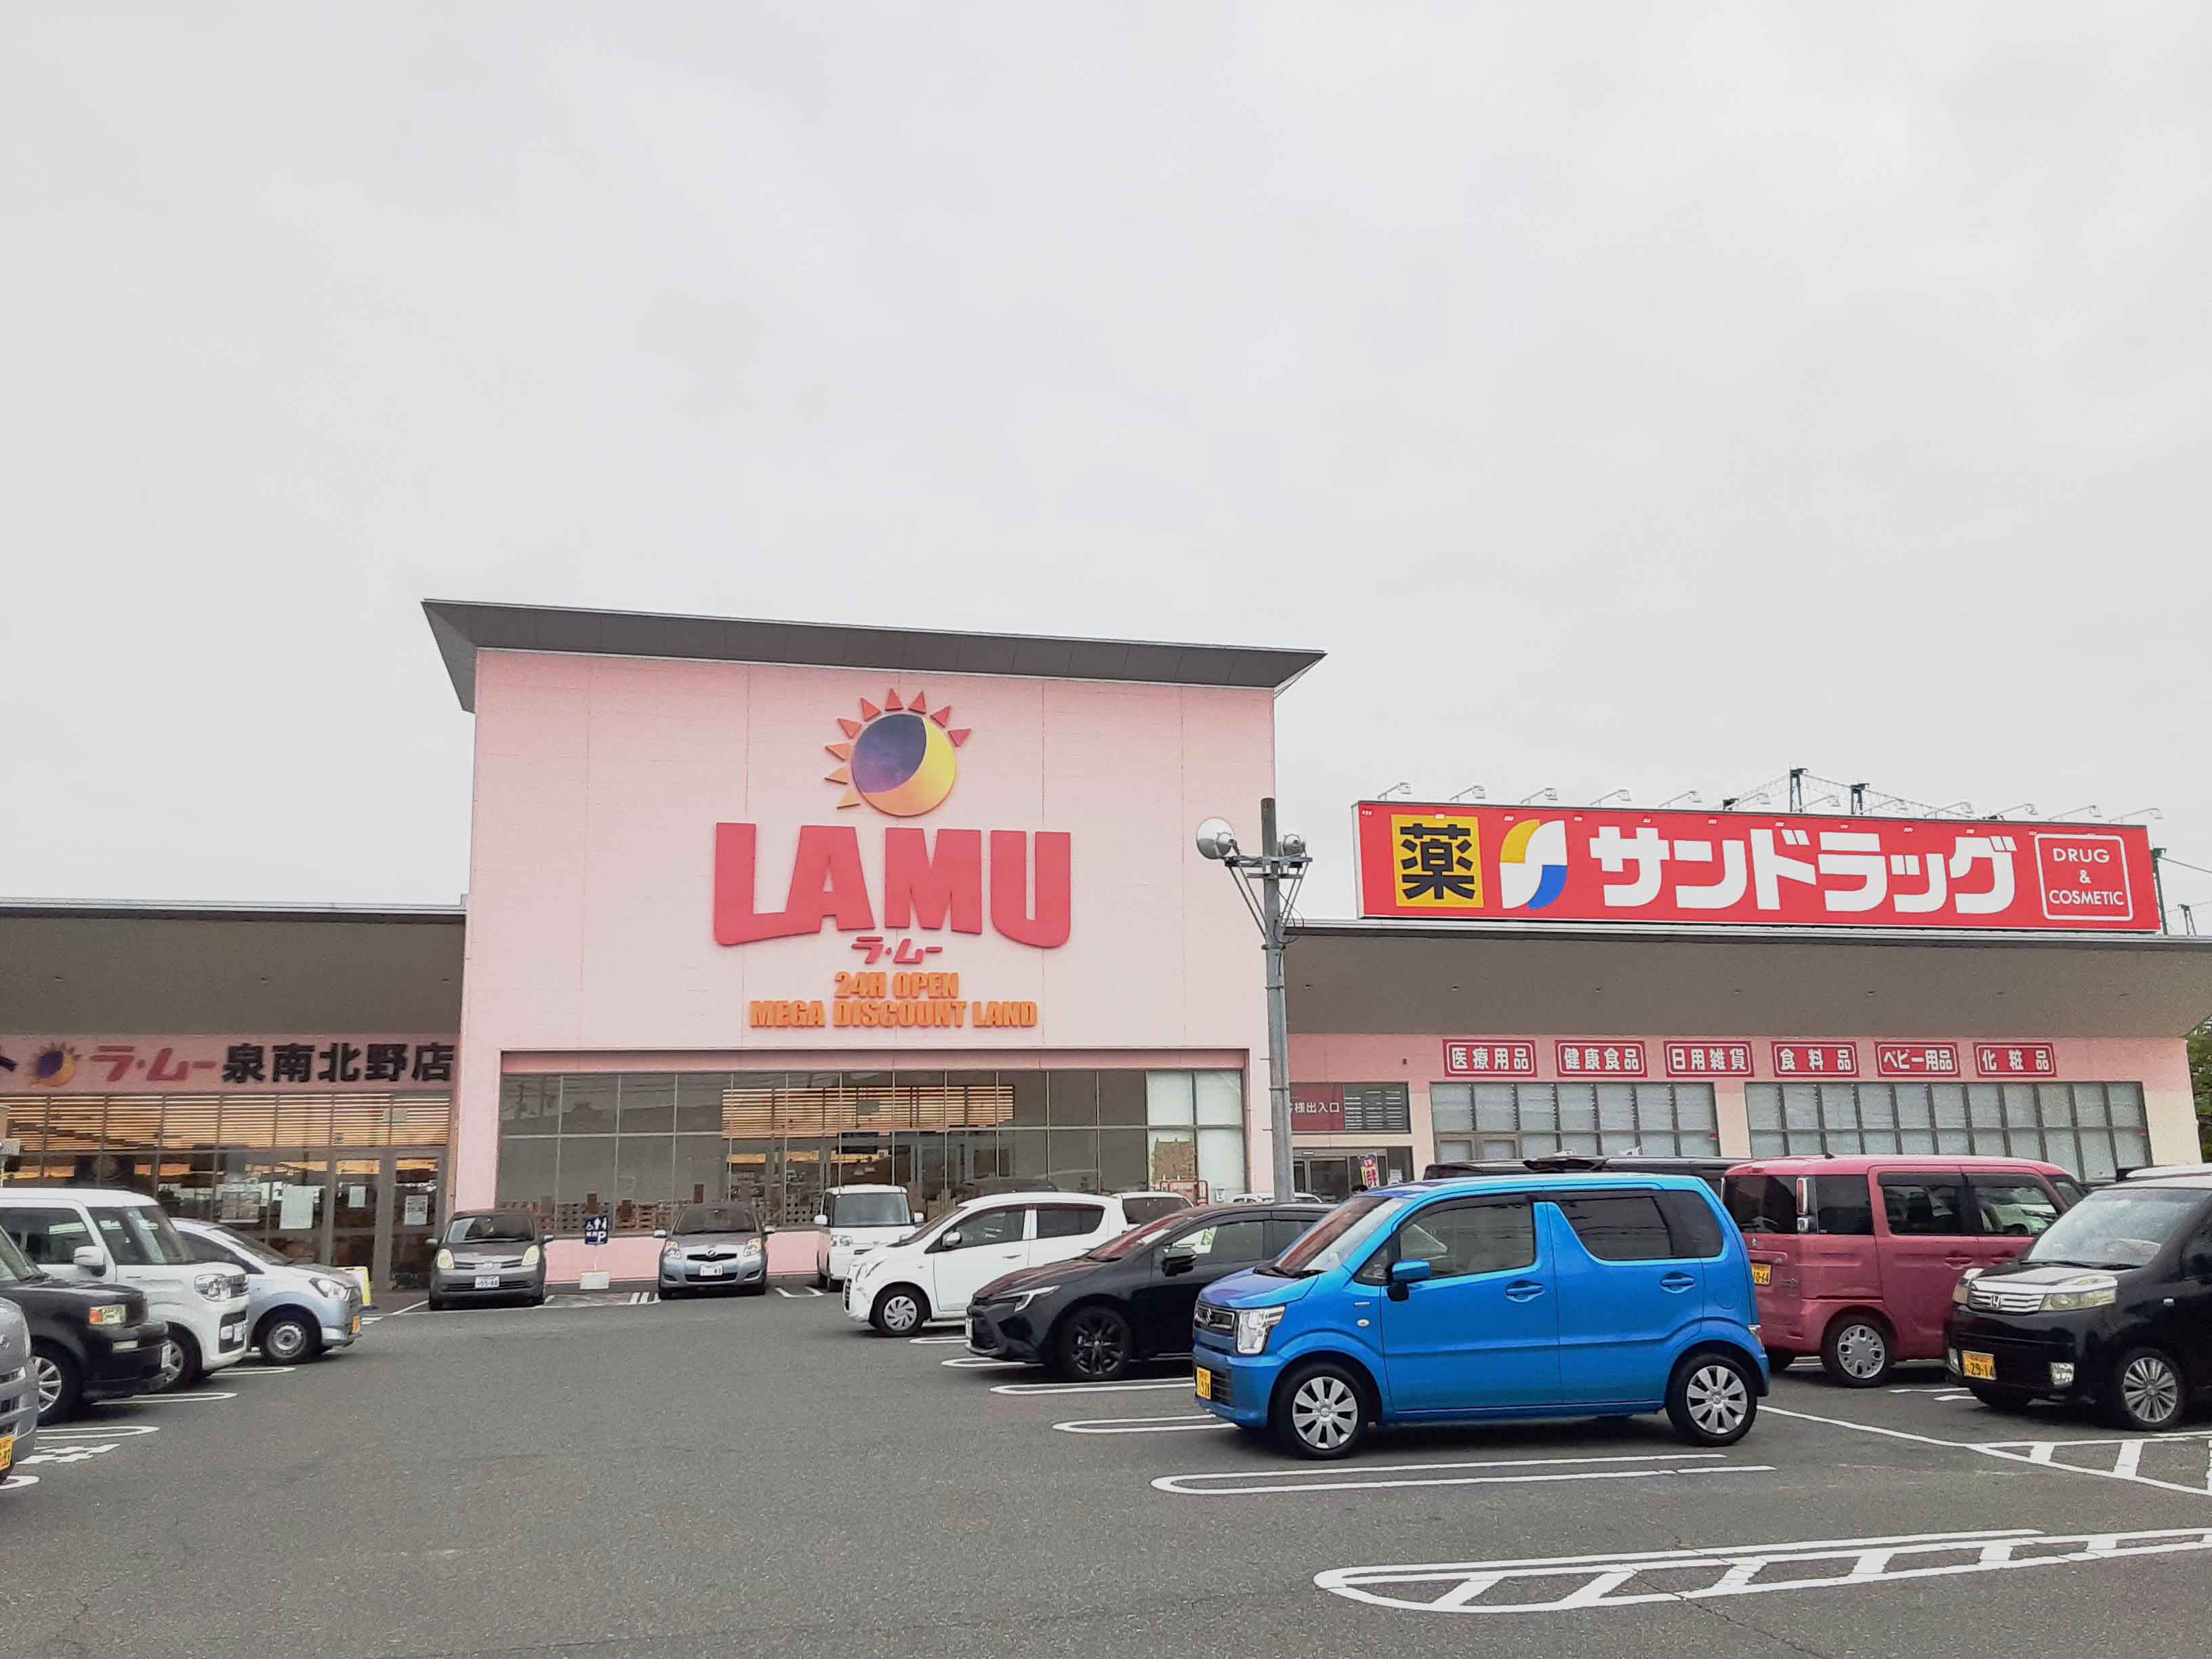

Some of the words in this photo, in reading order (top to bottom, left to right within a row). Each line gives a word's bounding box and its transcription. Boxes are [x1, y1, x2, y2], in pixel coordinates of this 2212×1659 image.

[1399, 823, 1475, 900] 薬
[2053, 847, 2110, 863] DRUG
[1589, 825, 2018, 914] サンドラッグ
[2079, 869, 2092, 884] &
[714, 822, 1071, 949] LAMU
[2049, 889, 2125, 905] COSMETIC
[834, 972, 885, 998] 24H
[892, 972, 960, 998] OPEN
[749, 1000, 826, 1027] MEGA
[833, 1000, 966, 1028] DISCOUNT
[972, 1001, 1038, 1027] LAND
[221, 1042, 456, 1084] 泉南北野店
[1452, 1047, 1530, 1070] 医療用品
[1563, 1047, 1643, 1071] 健康食品
[1671, 1048, 1746, 1071] 日用雑貨
[1780, 1048, 1852, 1071] 食料品
[1982, 1048, 2050, 1071] 化粧品
